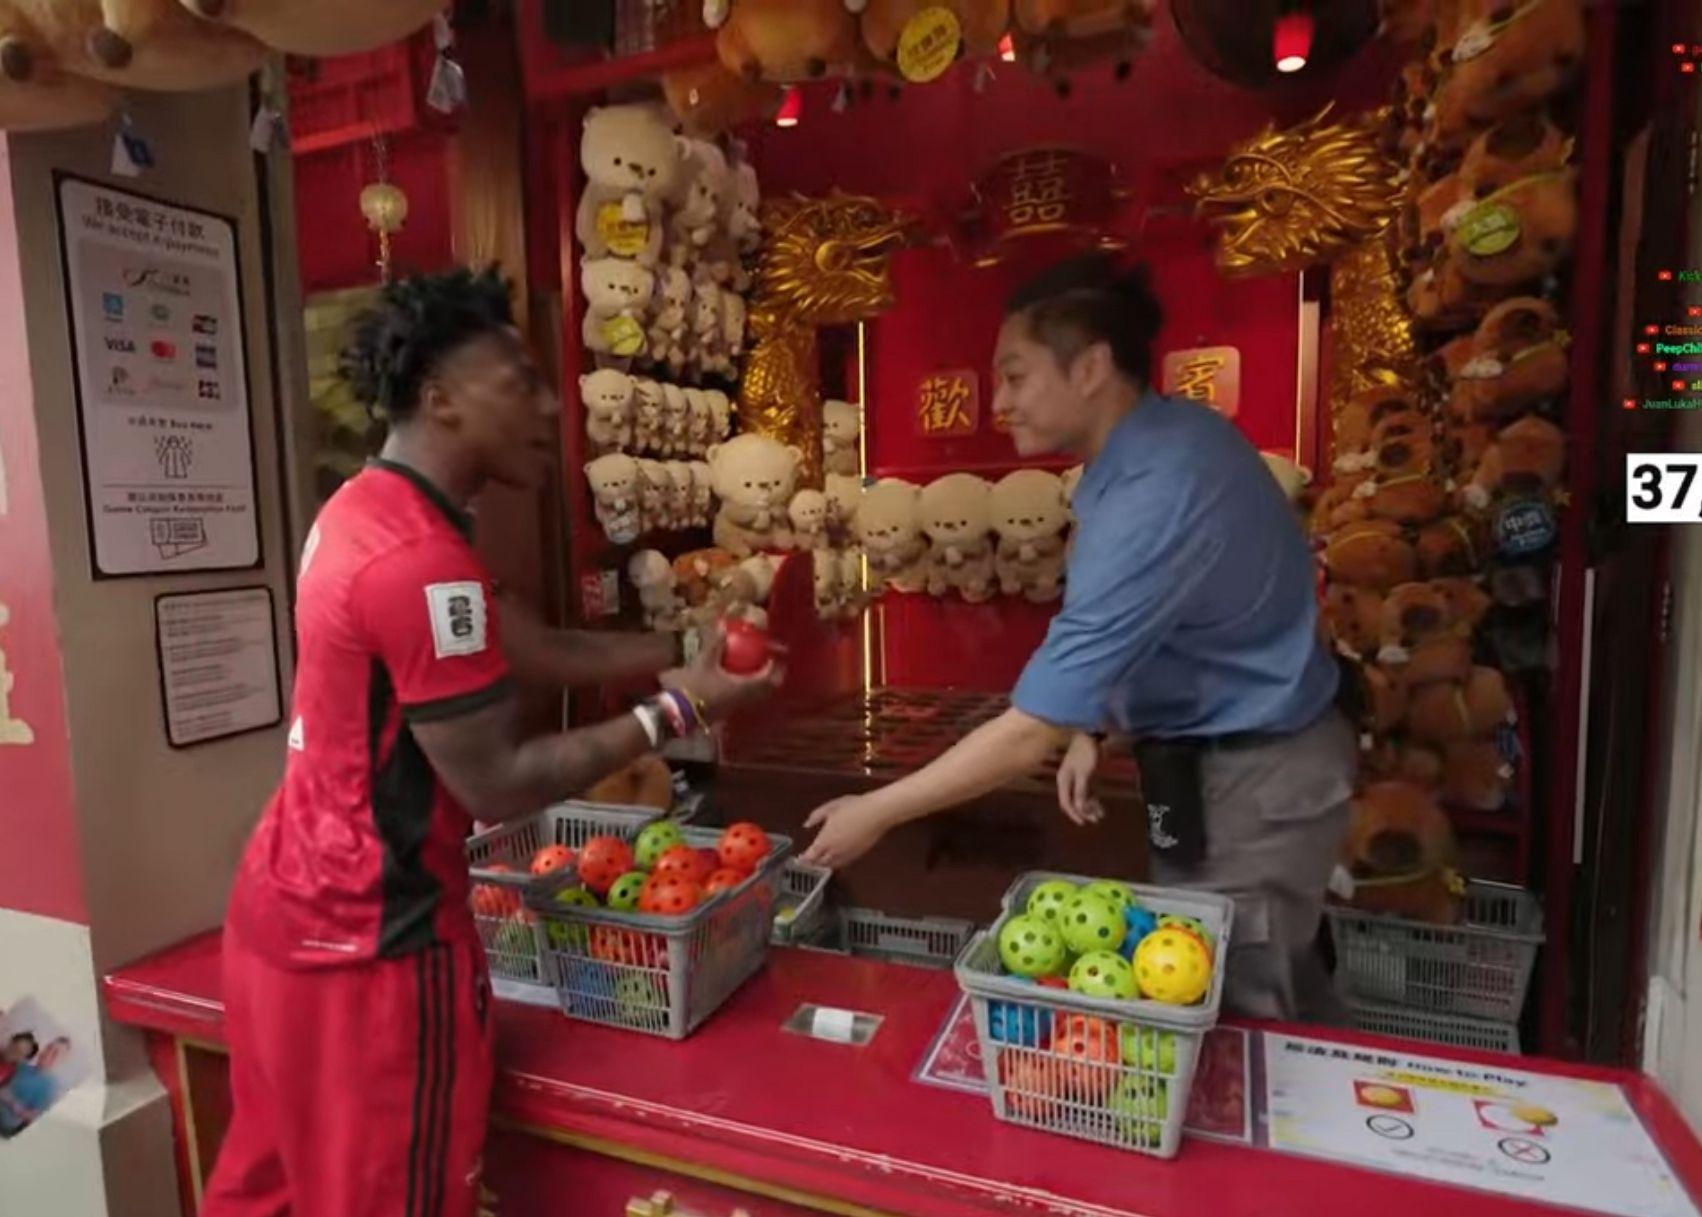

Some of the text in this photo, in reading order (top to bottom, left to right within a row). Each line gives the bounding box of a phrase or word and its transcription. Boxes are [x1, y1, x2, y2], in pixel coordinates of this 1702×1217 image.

[104, 337, 136, 352] VISA
[919, 376, 972, 434] 歡
[1407, 1061, 1452, 1075] How
[1457, 1069, 1480, 1080] to
[1484, 1073, 1527, 1088] Play
